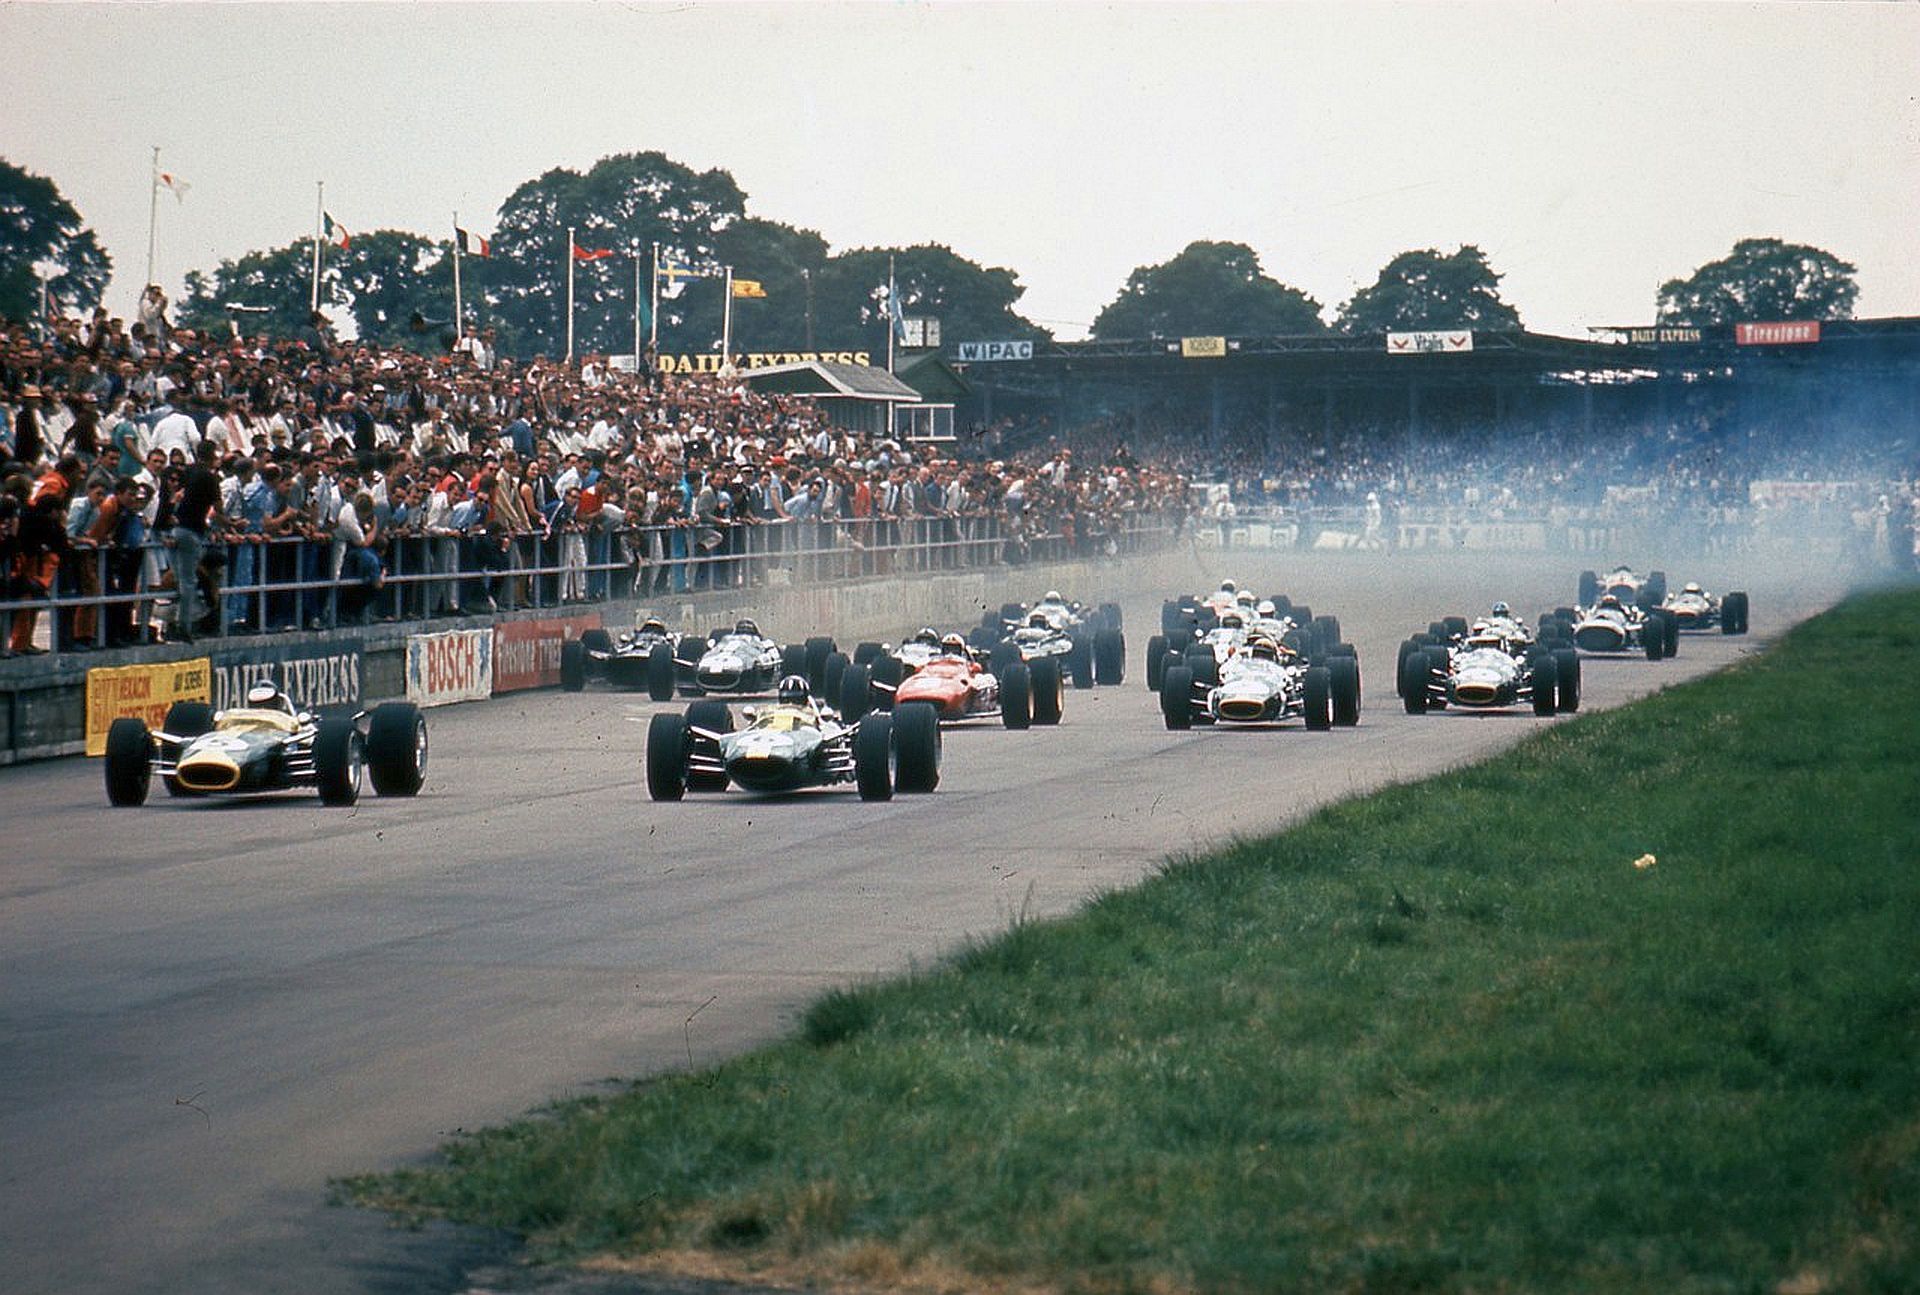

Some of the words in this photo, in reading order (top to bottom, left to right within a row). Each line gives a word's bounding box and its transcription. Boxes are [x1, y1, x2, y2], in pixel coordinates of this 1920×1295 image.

[962, 342, 1031, 359] WIPAC
[281, 652, 360, 709] EXPRESS
[427, 635, 475, 695] BOSCH
